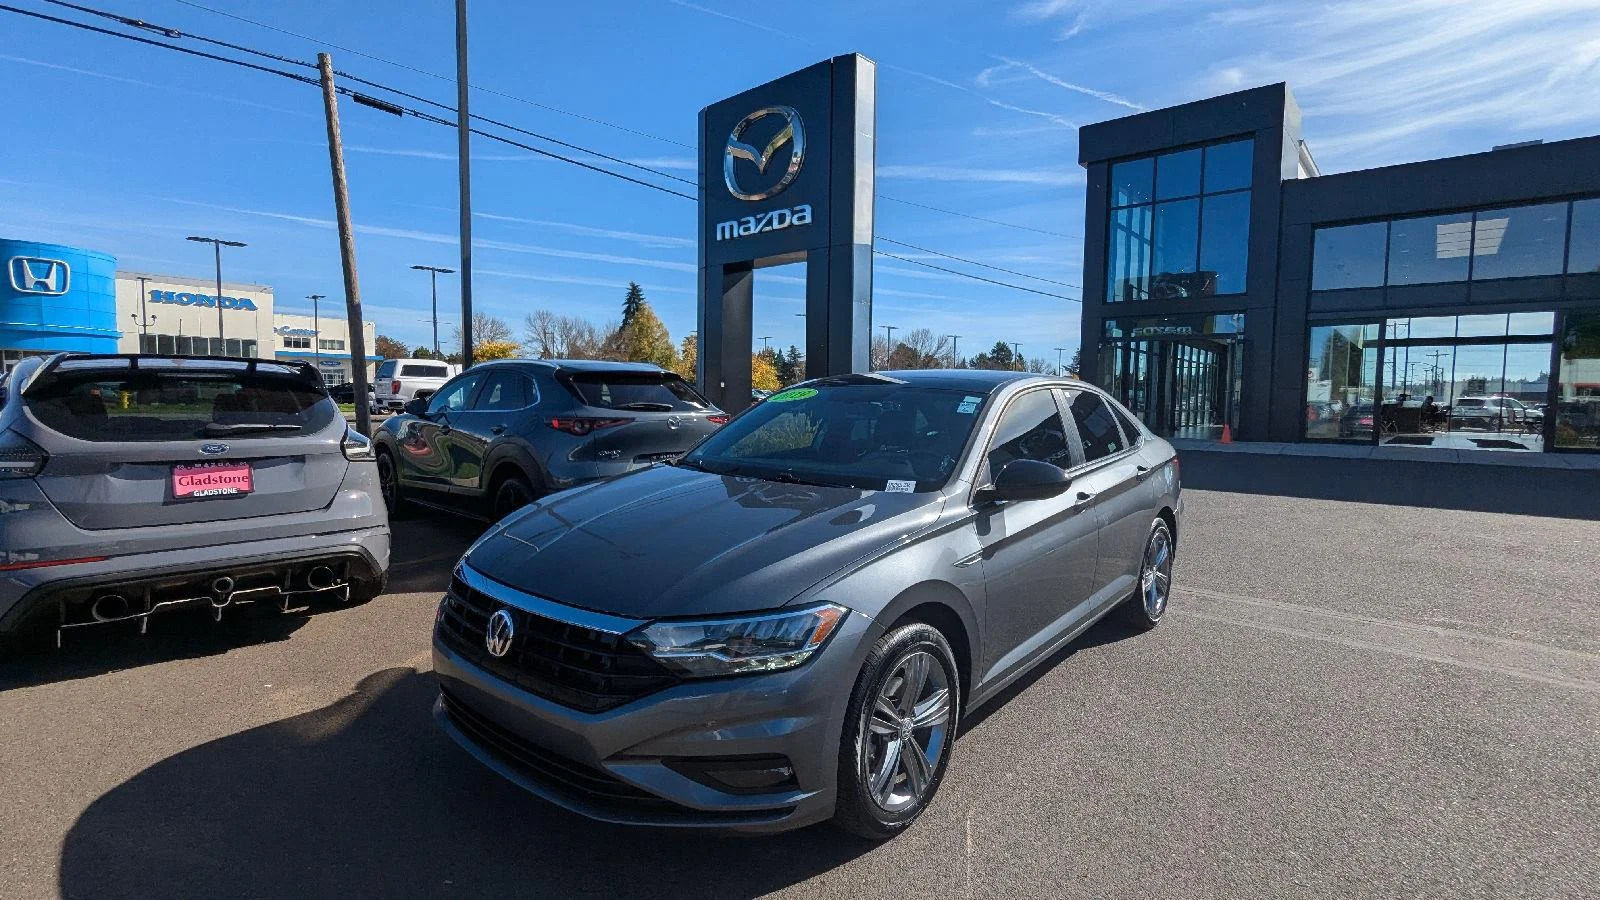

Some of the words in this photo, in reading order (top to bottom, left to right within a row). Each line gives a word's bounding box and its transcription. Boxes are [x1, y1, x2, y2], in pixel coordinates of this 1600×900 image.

[148, 289, 258, 311] HONDA
[178, 475, 248, 487] Gladstone
[193, 487, 238, 497] GLADSTONE
